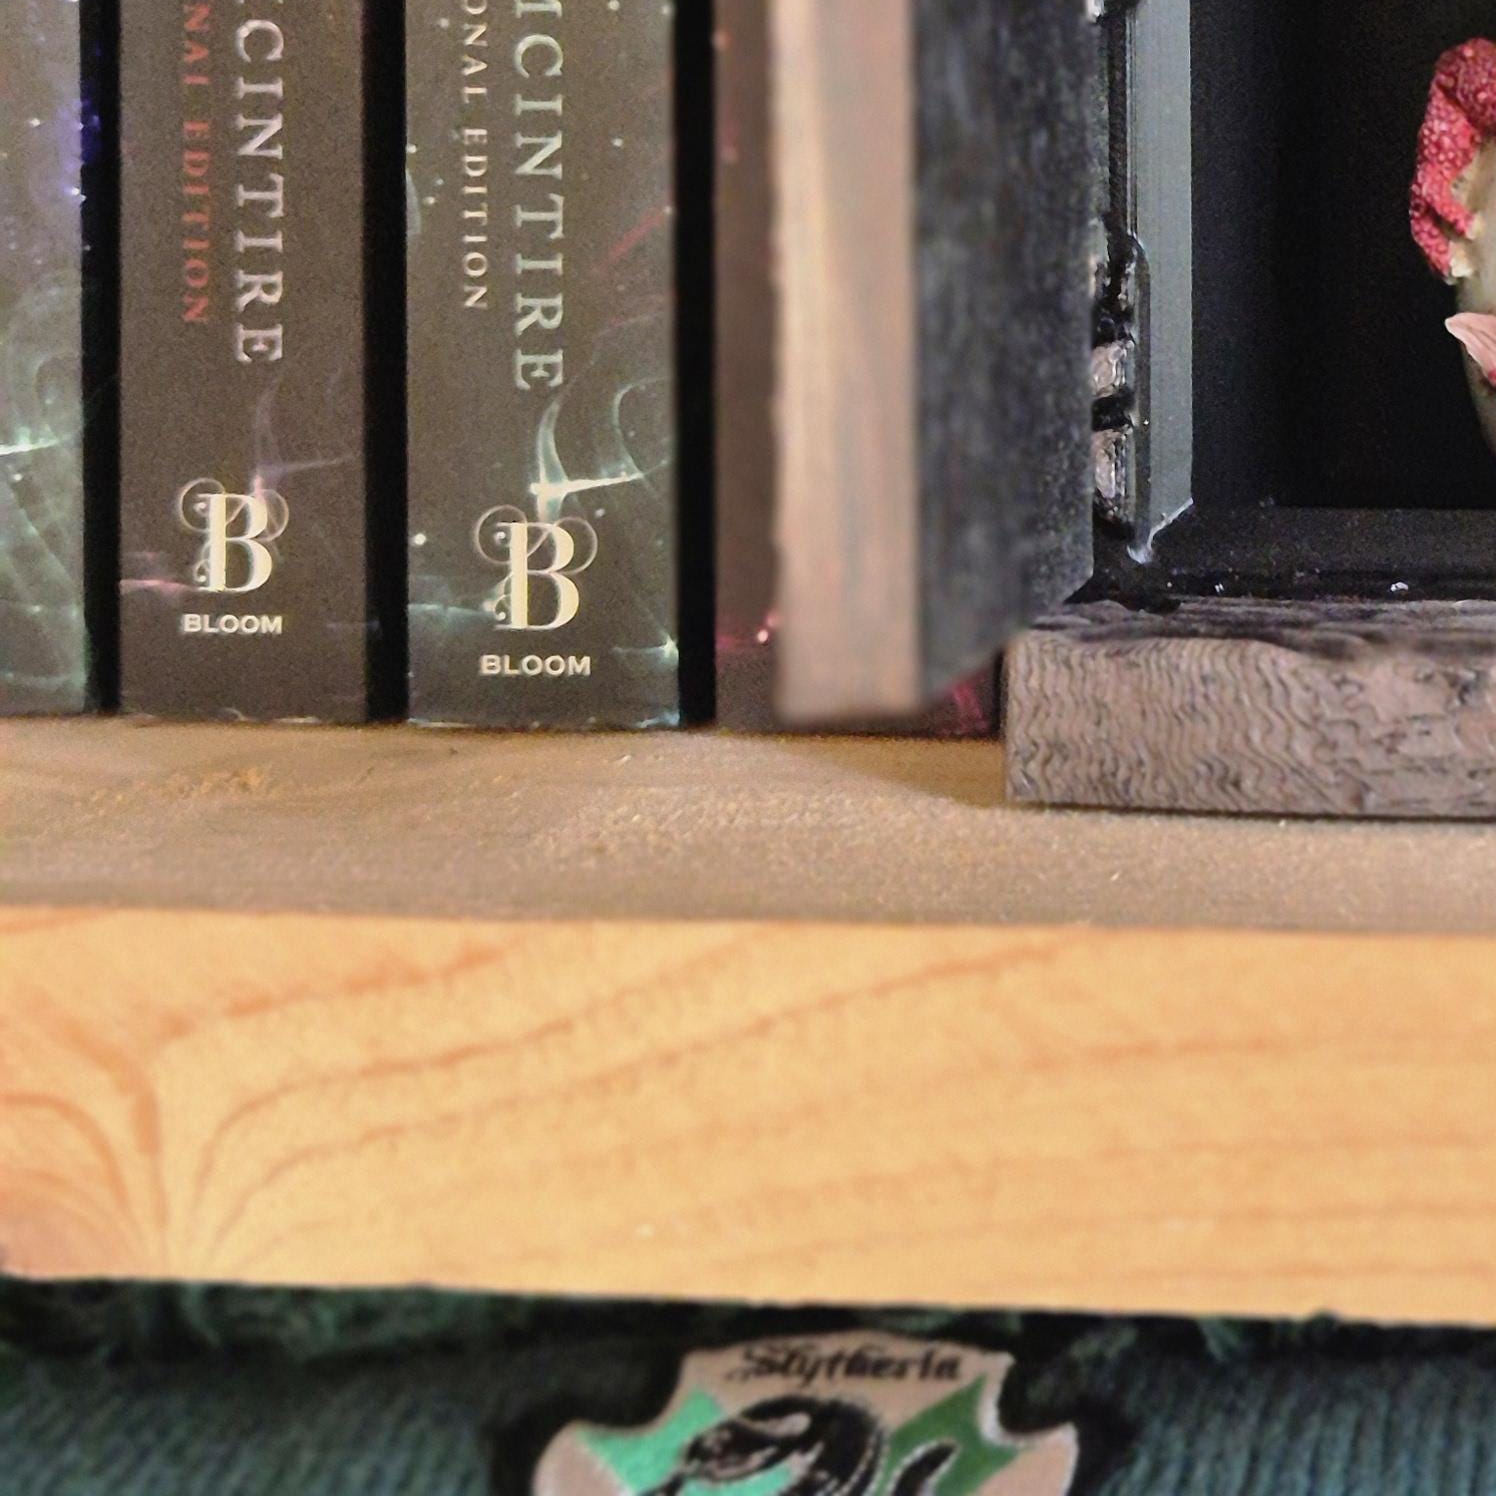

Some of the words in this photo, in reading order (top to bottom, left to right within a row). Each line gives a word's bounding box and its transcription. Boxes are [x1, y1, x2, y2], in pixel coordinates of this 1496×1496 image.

[182, 118, 212, 325] EDITION
[462, 126, 488, 310] EDITION
[183, 613, 283, 635] BLOOM
[480, 654, 592, 676] BLOOM
